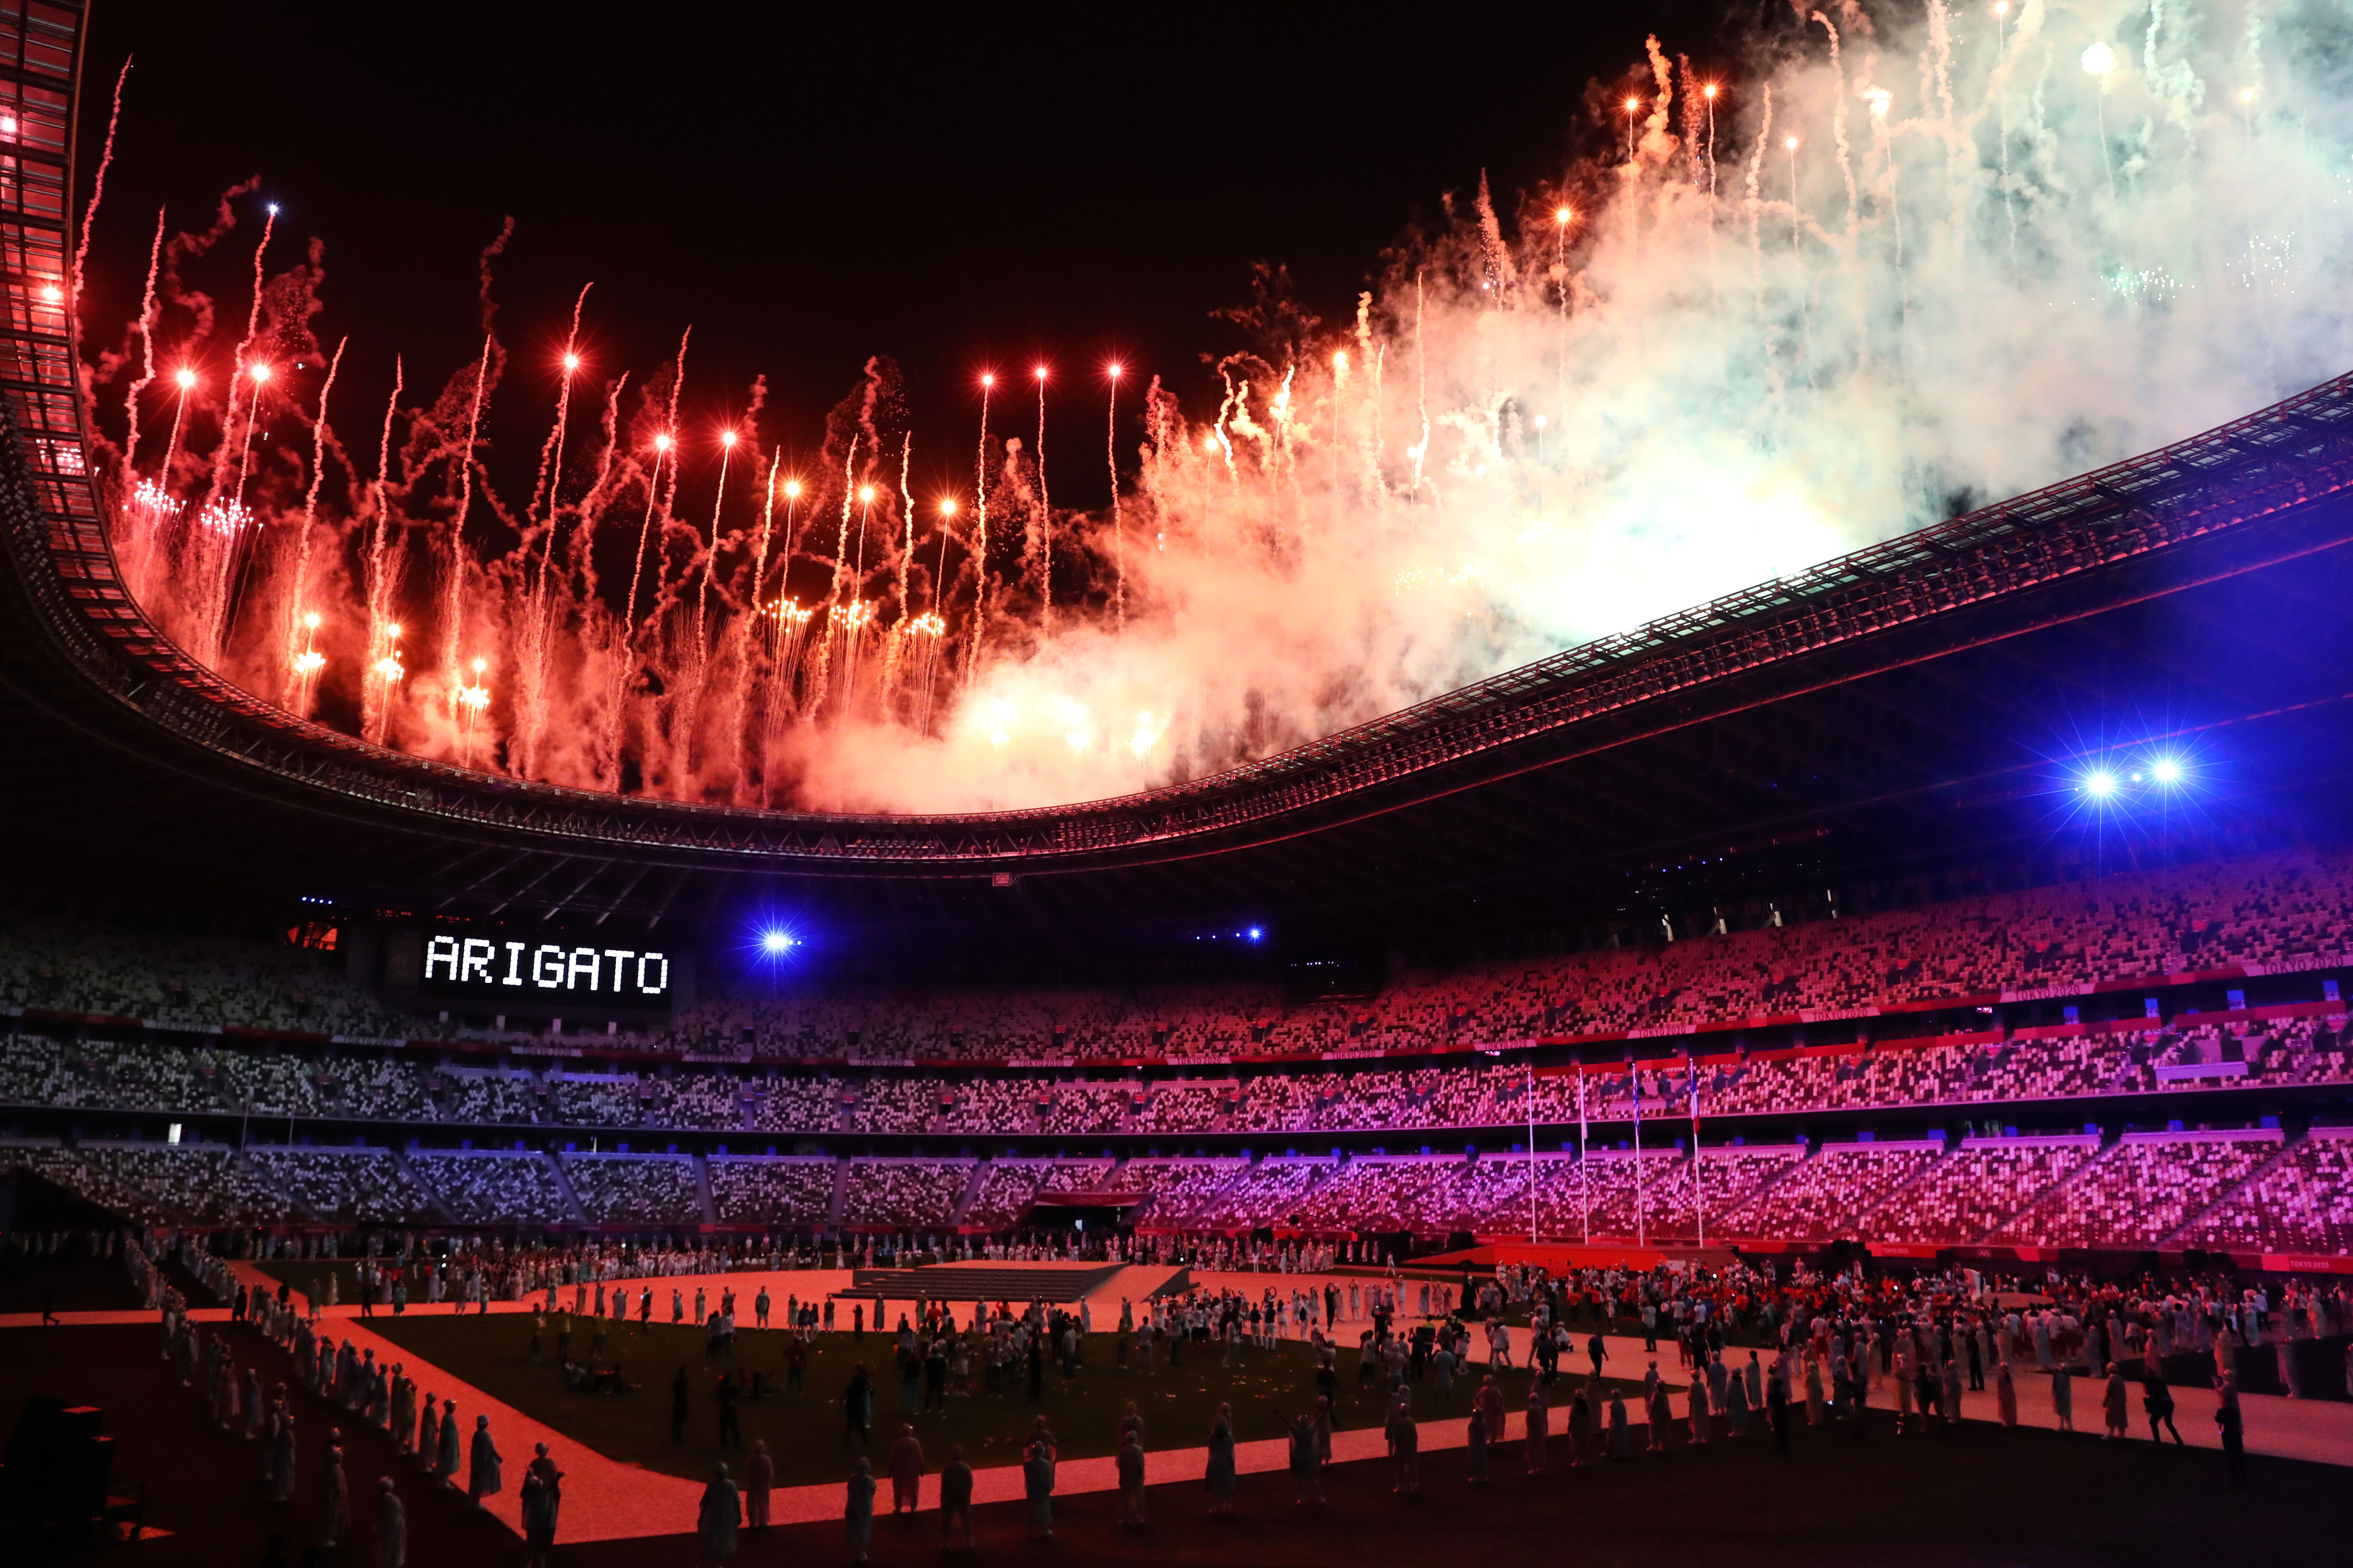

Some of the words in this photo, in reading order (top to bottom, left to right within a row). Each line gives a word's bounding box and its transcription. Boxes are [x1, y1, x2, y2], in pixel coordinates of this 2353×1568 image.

[425, 935, 668, 994] ARIGATO
[2262, 959, 2306, 975] TOKYO
[2310, 956, 2343, 970] 2020
[2016, 988, 2050, 1002] TOKYO
[2054, 985, 2080, 997] 2020
[1812, 1010, 1842, 1022] TOKYO
[1845, 1008, 1867, 1019] 2020
[1639, 1028, 1664, 1038] TOKYO
[1666, 1026, 1685, 1036] 2020
